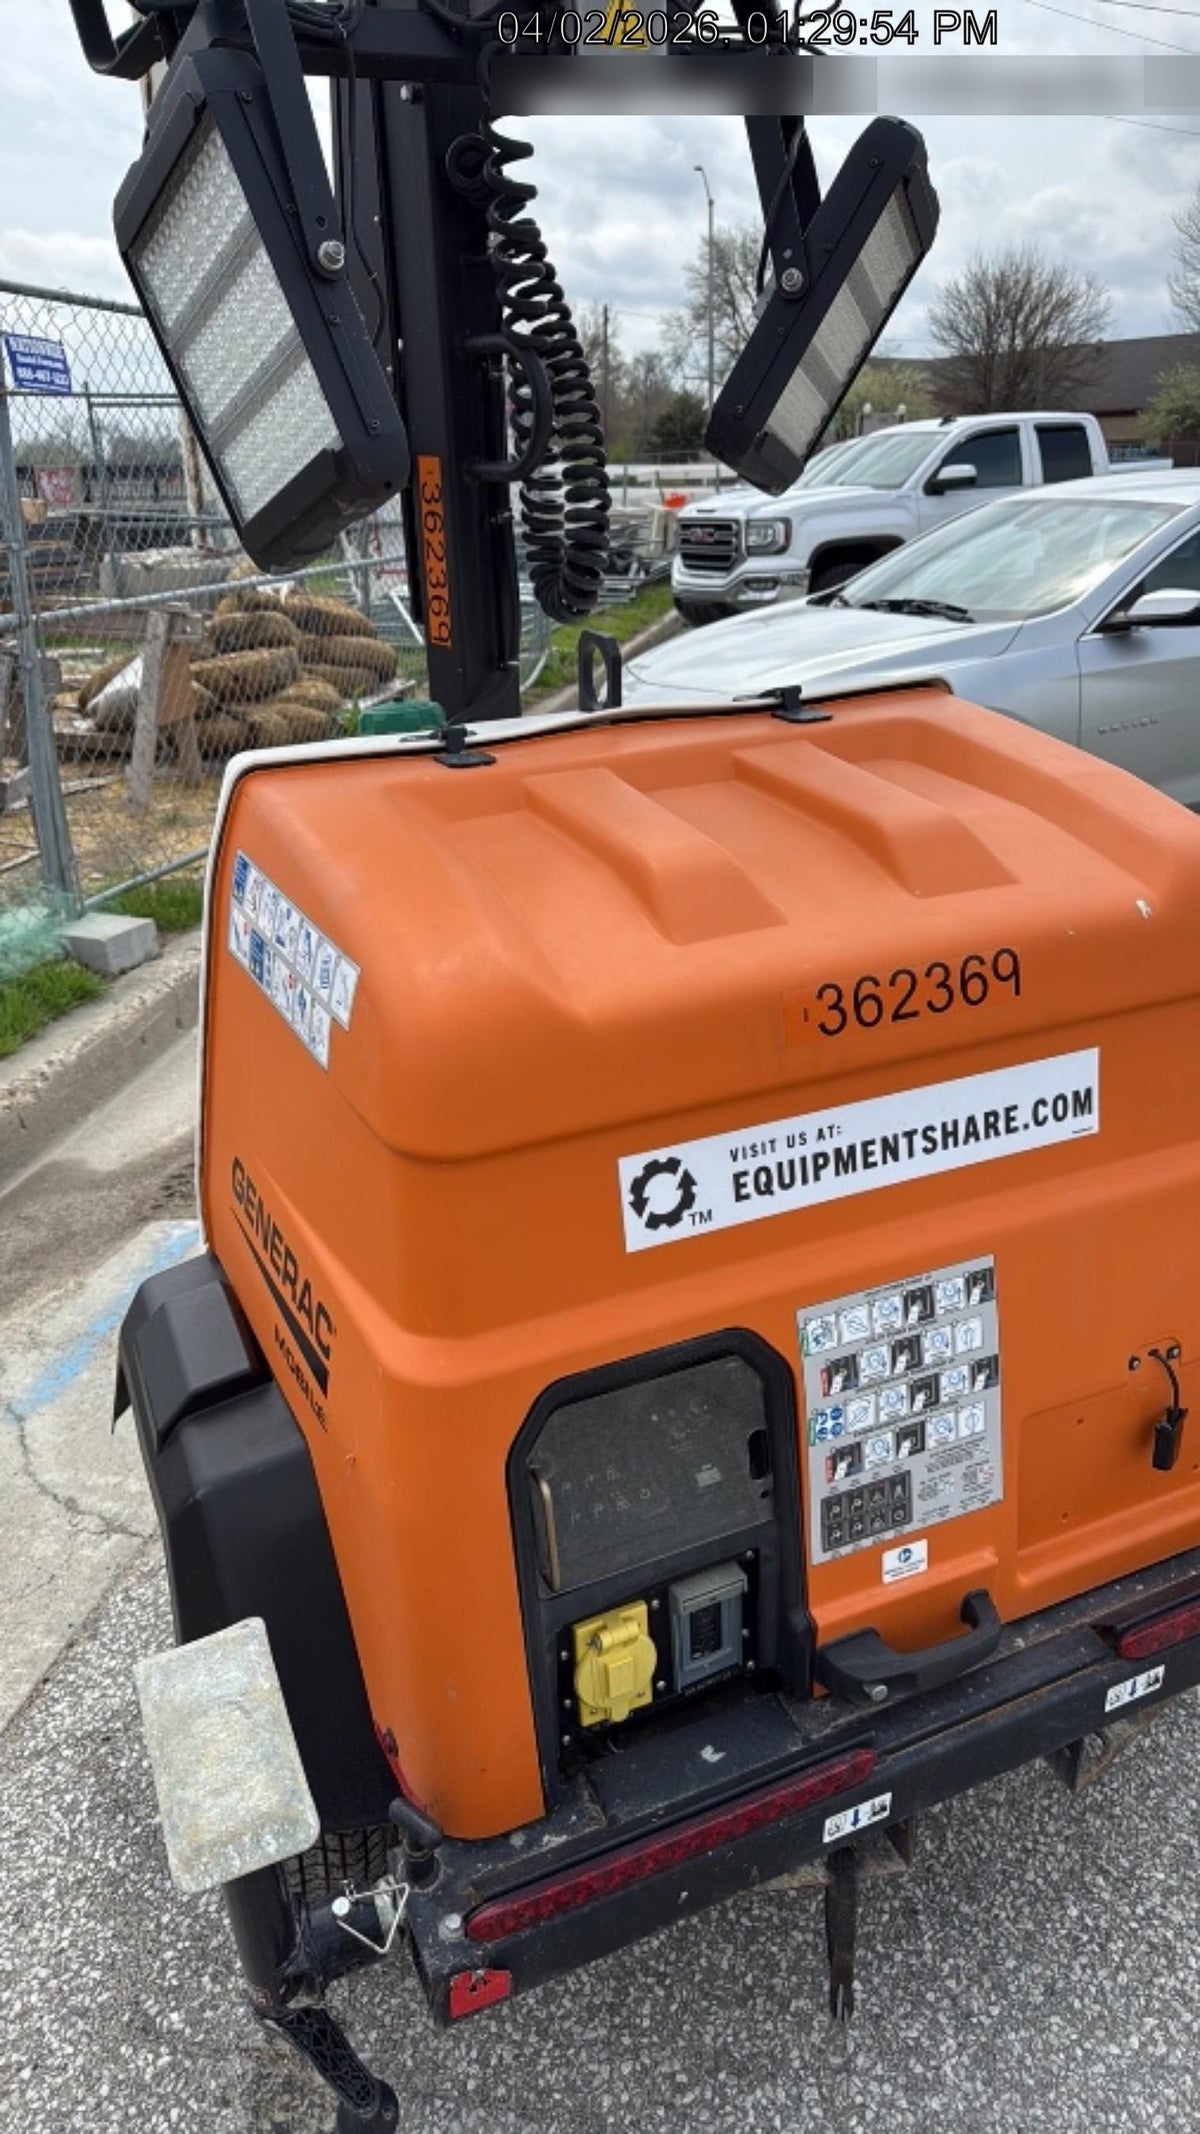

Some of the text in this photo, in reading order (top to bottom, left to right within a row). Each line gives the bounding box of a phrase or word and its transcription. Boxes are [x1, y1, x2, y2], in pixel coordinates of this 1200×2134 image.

[422, 481, 450, 643] 362369
[816, 948, 1020, 1036] 362369
[730, 1124, 842, 1162] VISIT US AT:
[732, 1086, 1092, 1203] EQUIPMENTSHARE.COM
[231, 1156, 332, 1361] GENERAC
[688, 1208, 713, 1226] TM
